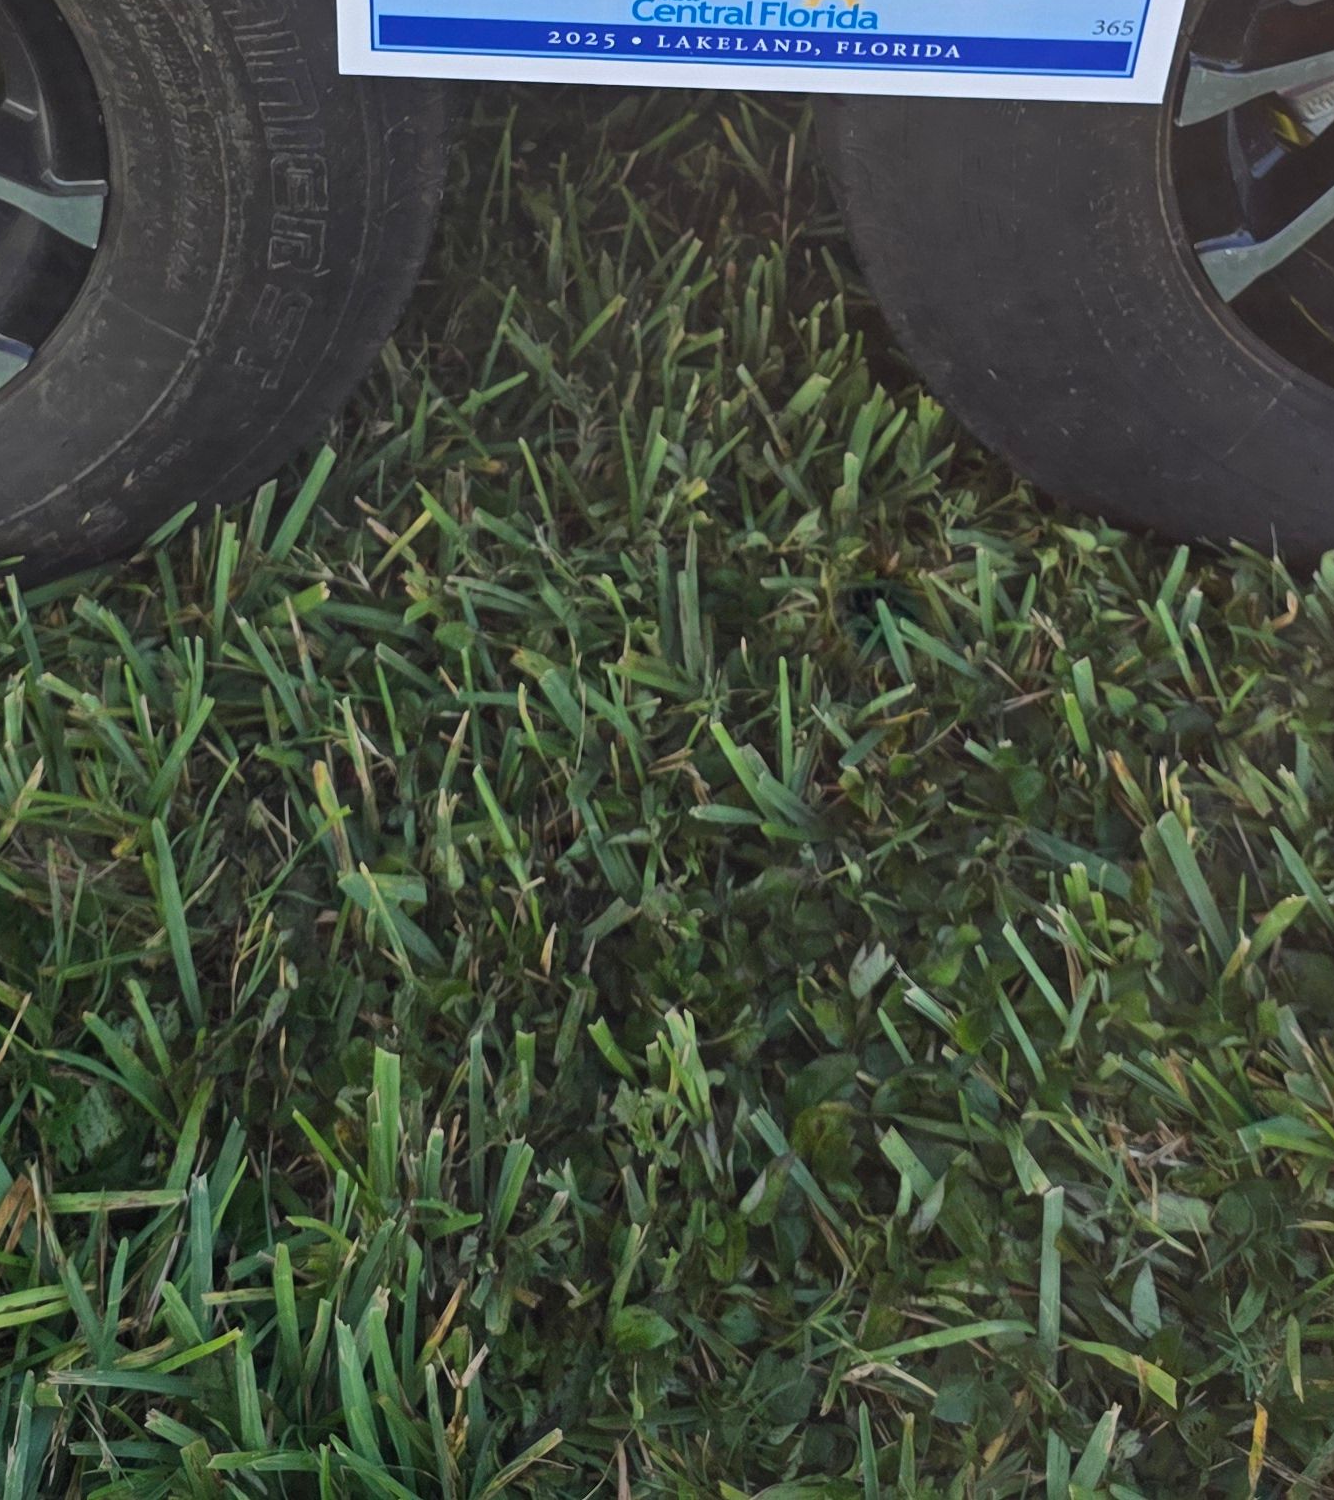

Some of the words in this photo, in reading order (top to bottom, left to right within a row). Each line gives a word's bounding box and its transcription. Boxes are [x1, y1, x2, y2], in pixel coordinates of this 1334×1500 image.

[759, 0, 879, 31] Florida
[1092, 19, 1135, 36] 365
[547, 30, 616, 50] 2025
[657, 34, 821, 56] LAKELAND,
[836, 40, 960, 59] FLORIDA
